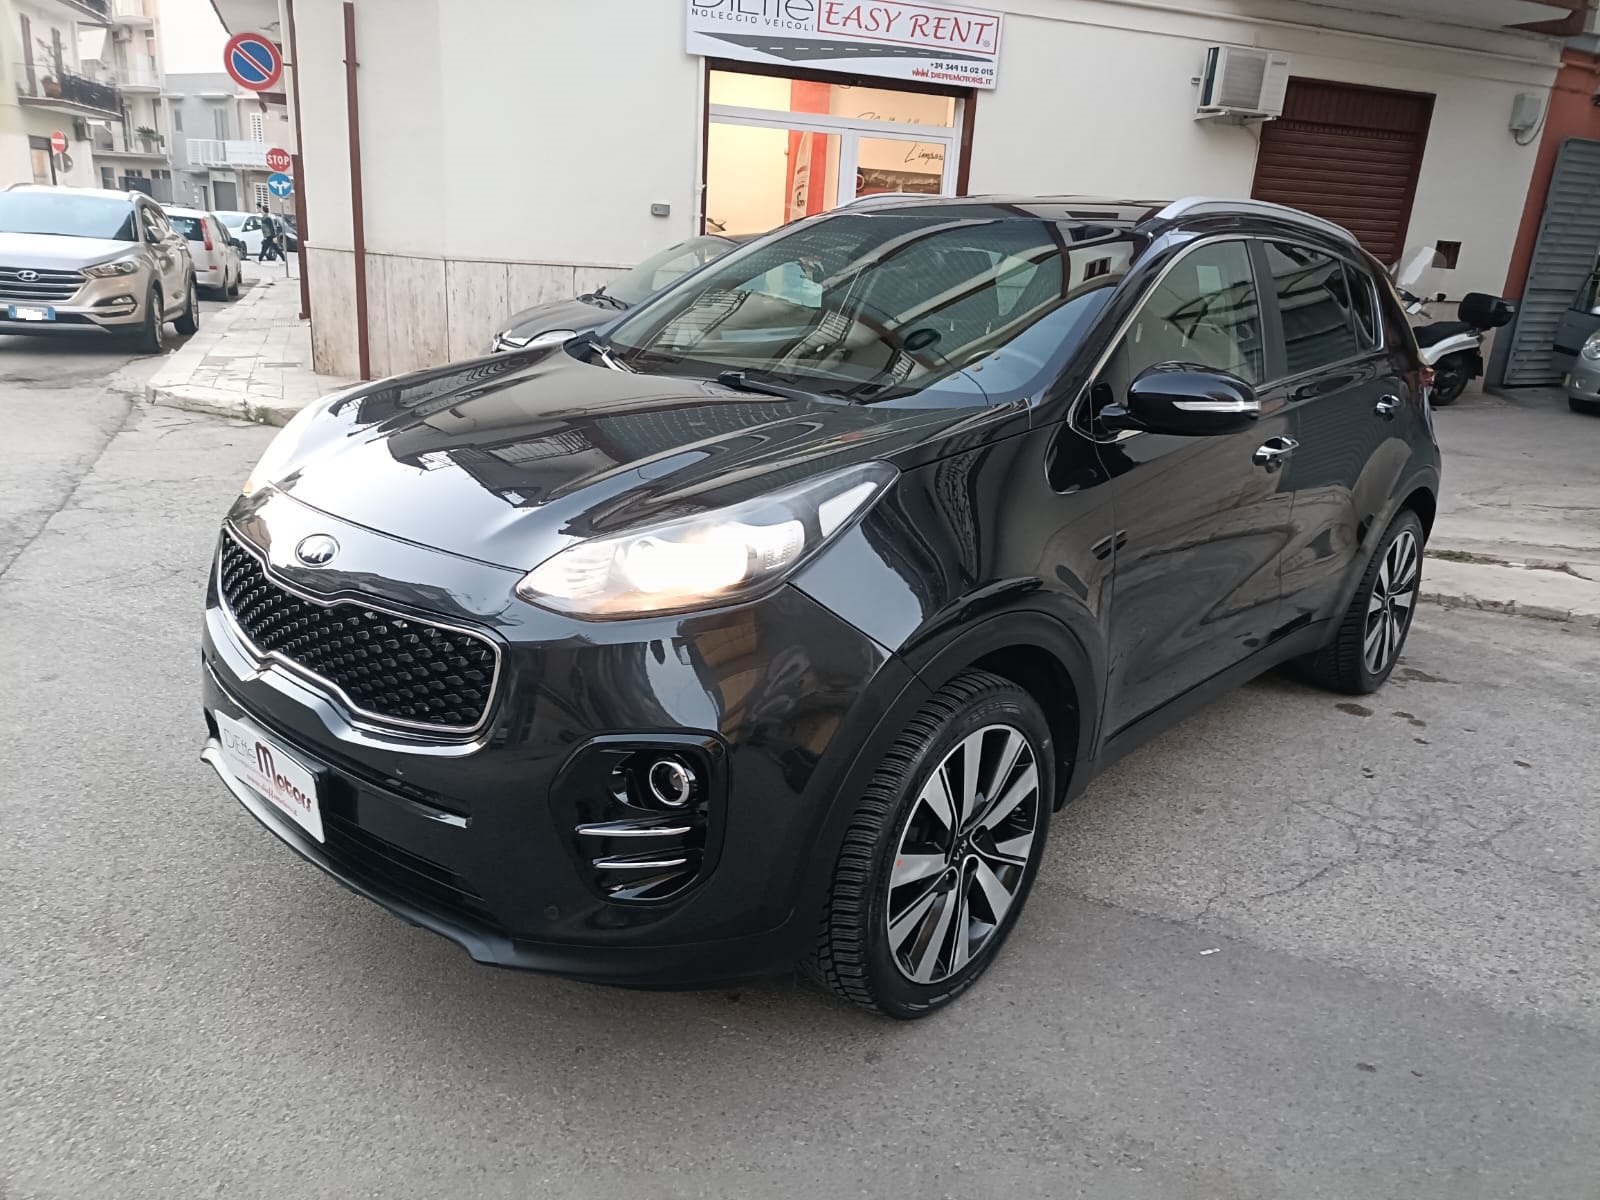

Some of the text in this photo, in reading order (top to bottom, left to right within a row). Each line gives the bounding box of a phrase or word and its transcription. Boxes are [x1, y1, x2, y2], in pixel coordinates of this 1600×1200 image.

[691, 8, 758, 24] NOLEGGIO
[764, 18, 815, 32] VEICOLI
[825, 1, 902, 33] EASY
[909, 13, 994, 45] RENT
[969, 67, 979, 75] 02
[980, 68, 994, 76] 015
[267, 154, 290, 166] STOP
